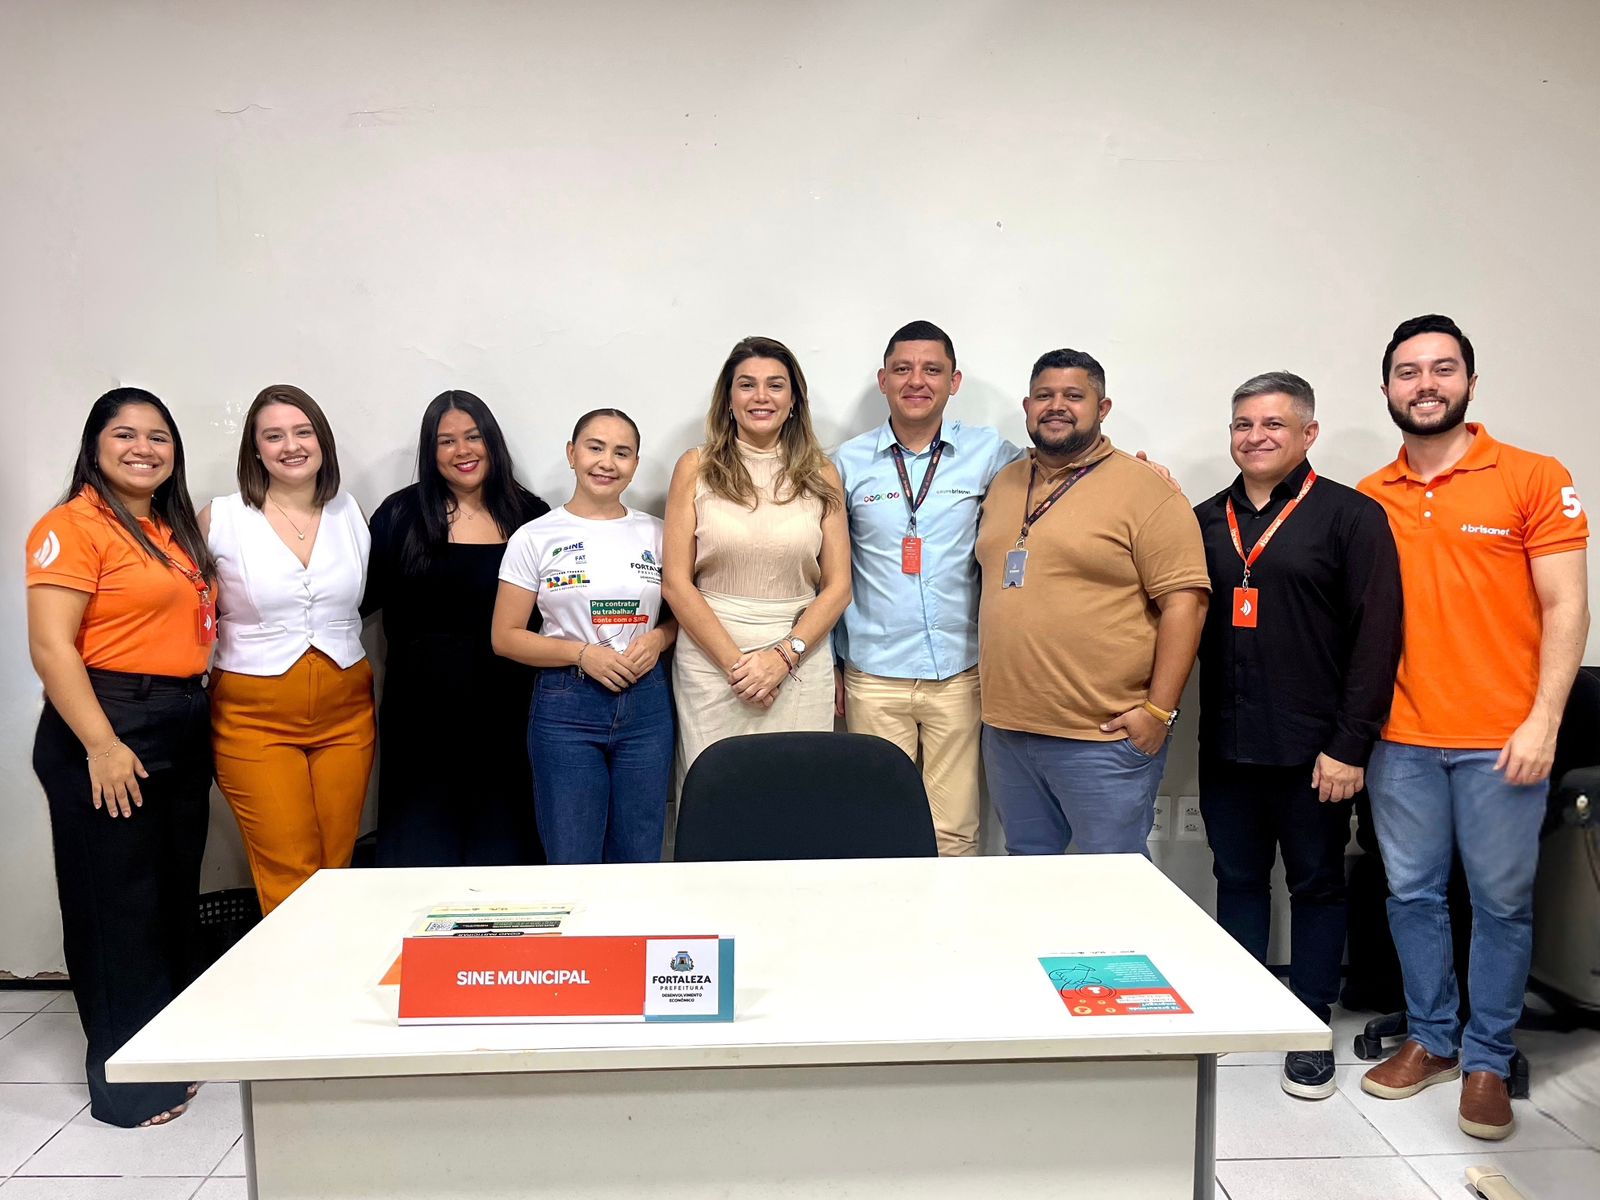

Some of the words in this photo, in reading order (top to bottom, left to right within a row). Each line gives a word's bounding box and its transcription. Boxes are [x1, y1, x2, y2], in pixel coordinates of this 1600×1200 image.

[457, 970, 495, 986] SINE
[498, 969, 590, 985] MUNICIPAL
[652, 975, 712, 984] FORTALEZA
